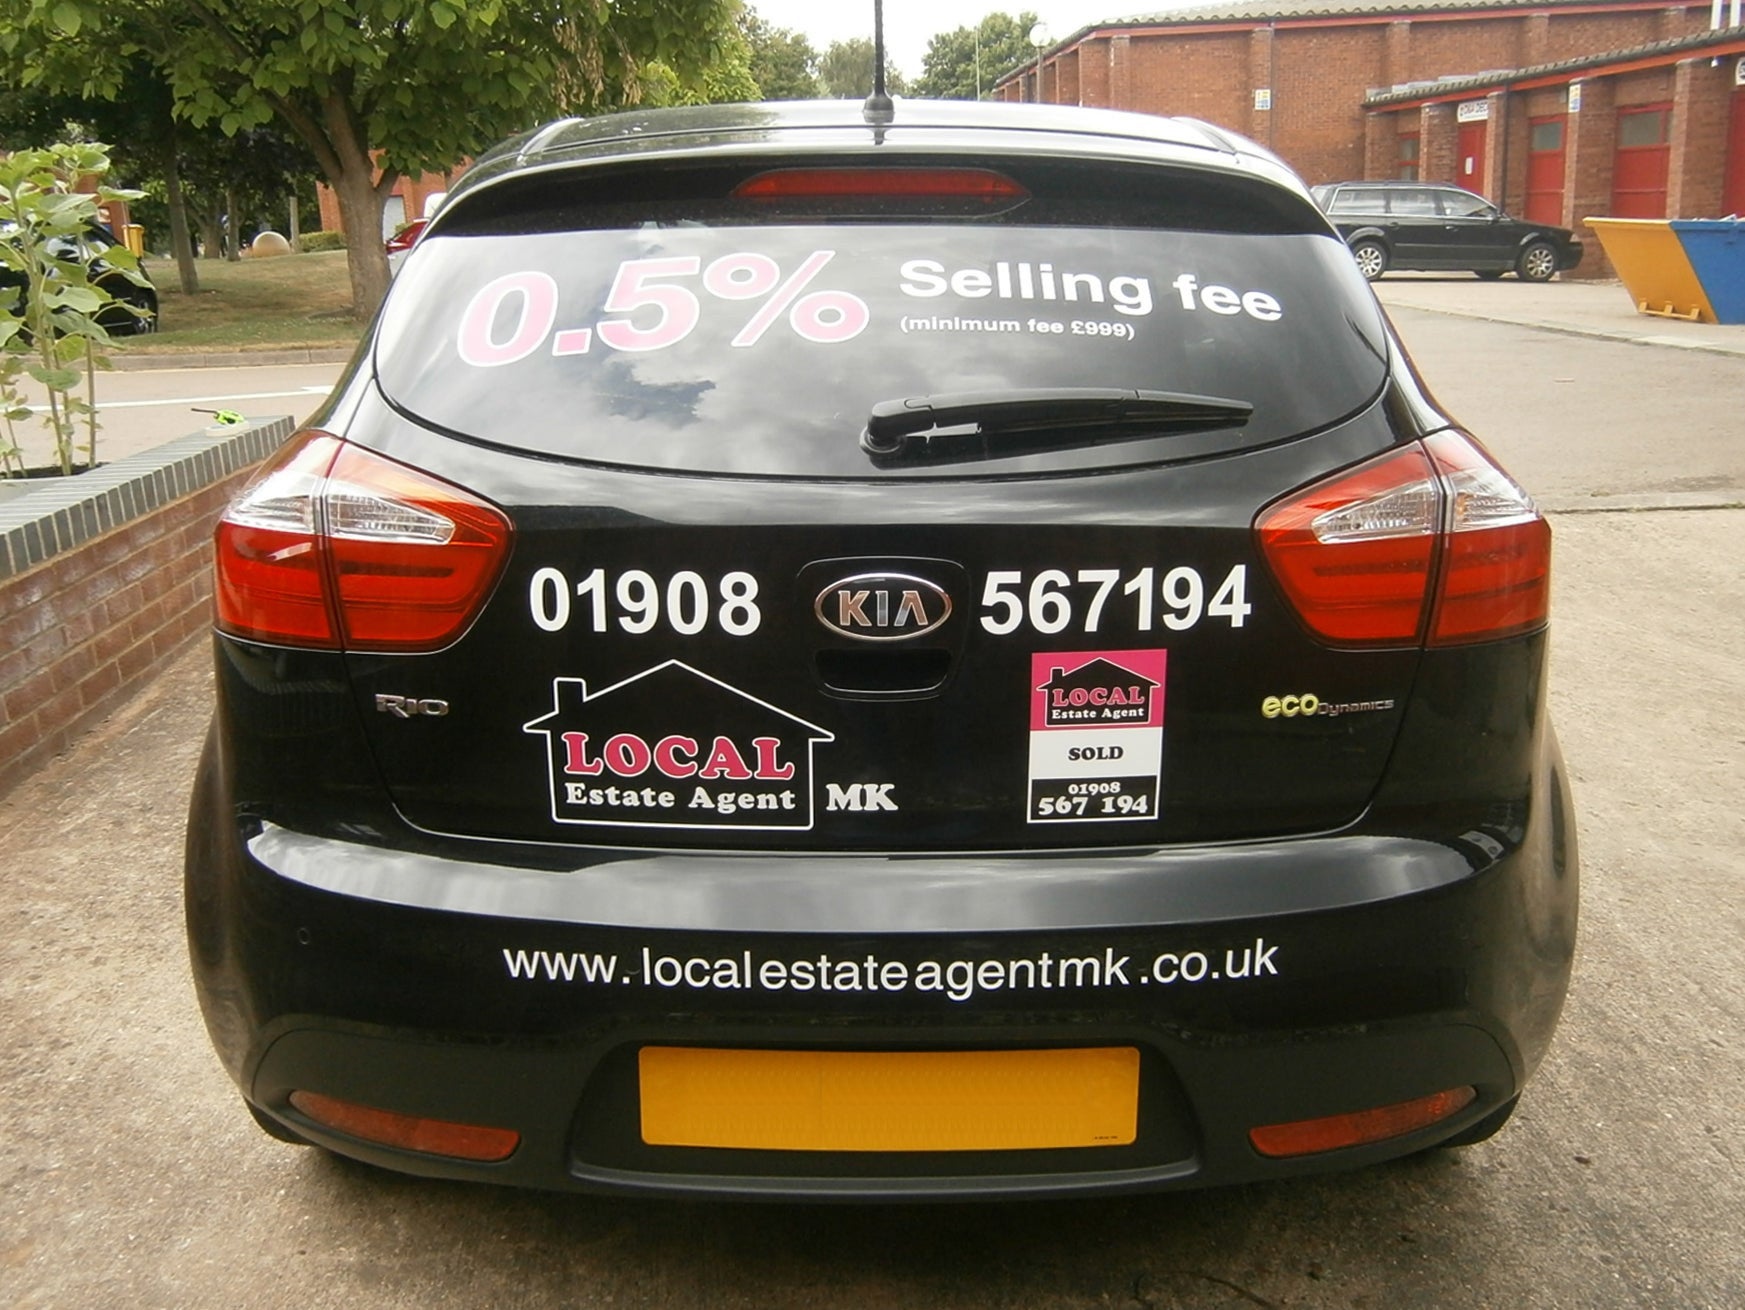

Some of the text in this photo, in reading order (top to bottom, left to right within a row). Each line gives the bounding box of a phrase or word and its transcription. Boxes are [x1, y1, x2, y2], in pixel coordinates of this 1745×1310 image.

[898, 259, 1284, 322] Selling fee
[457, 250, 869, 368] 0.5%
[899, 315, 1135, 341] (minimum fee £999)
[530, 567, 761, 636] 01908
[838, 590, 929, 627] KIA
[980, 564, 1251, 635] 567194
[375, 693, 449, 718] RIO
[1052, 687, 1145, 707] LOCAL
[1052, 707, 1145, 720] Estate Agent
[561, 732, 796, 780] LOCAL
[1068, 746, 1124, 761] SOLD
[565, 782, 796, 815] Estate Agent
[826, 783, 899, 812] MK
[1068, 782, 1121, 795] 01908
[1038, 795, 1148, 816] 567 194
